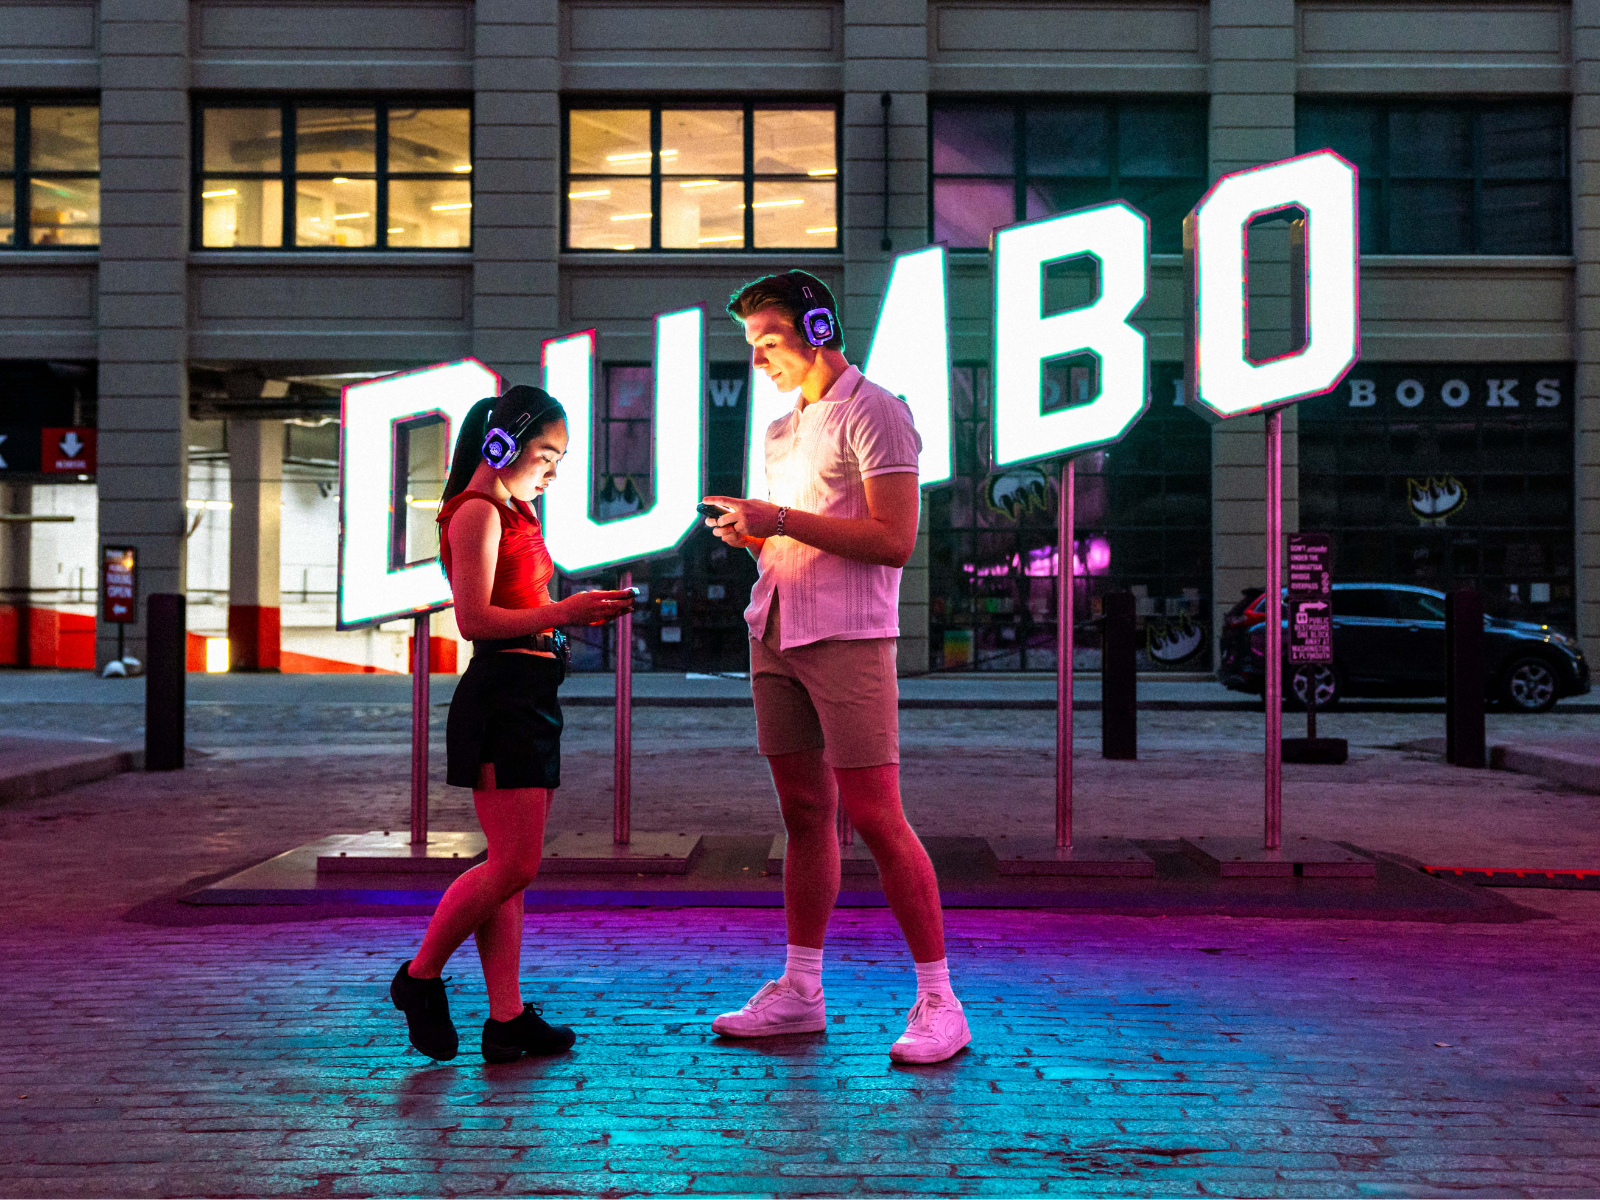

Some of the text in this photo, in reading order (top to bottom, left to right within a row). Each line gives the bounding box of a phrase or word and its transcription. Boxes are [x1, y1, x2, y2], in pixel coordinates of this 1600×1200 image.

[1349, 379, 1561, 407] BOOKS
[1290, 554, 1319, 562] UNDER THE
[1290, 563, 1323, 571] MANHATTAN
[1291, 573, 1310, 581] BRIDGE
[1291, 582, 1319, 590] OVERPASS
[107, 585, 132, 598] OPEN
[1309, 616, 1329, 625] PUBLIC
[1297, 630, 1330, 639] ONE BLOCK
[1299, 651, 1330, 660] PLYMOUTH
